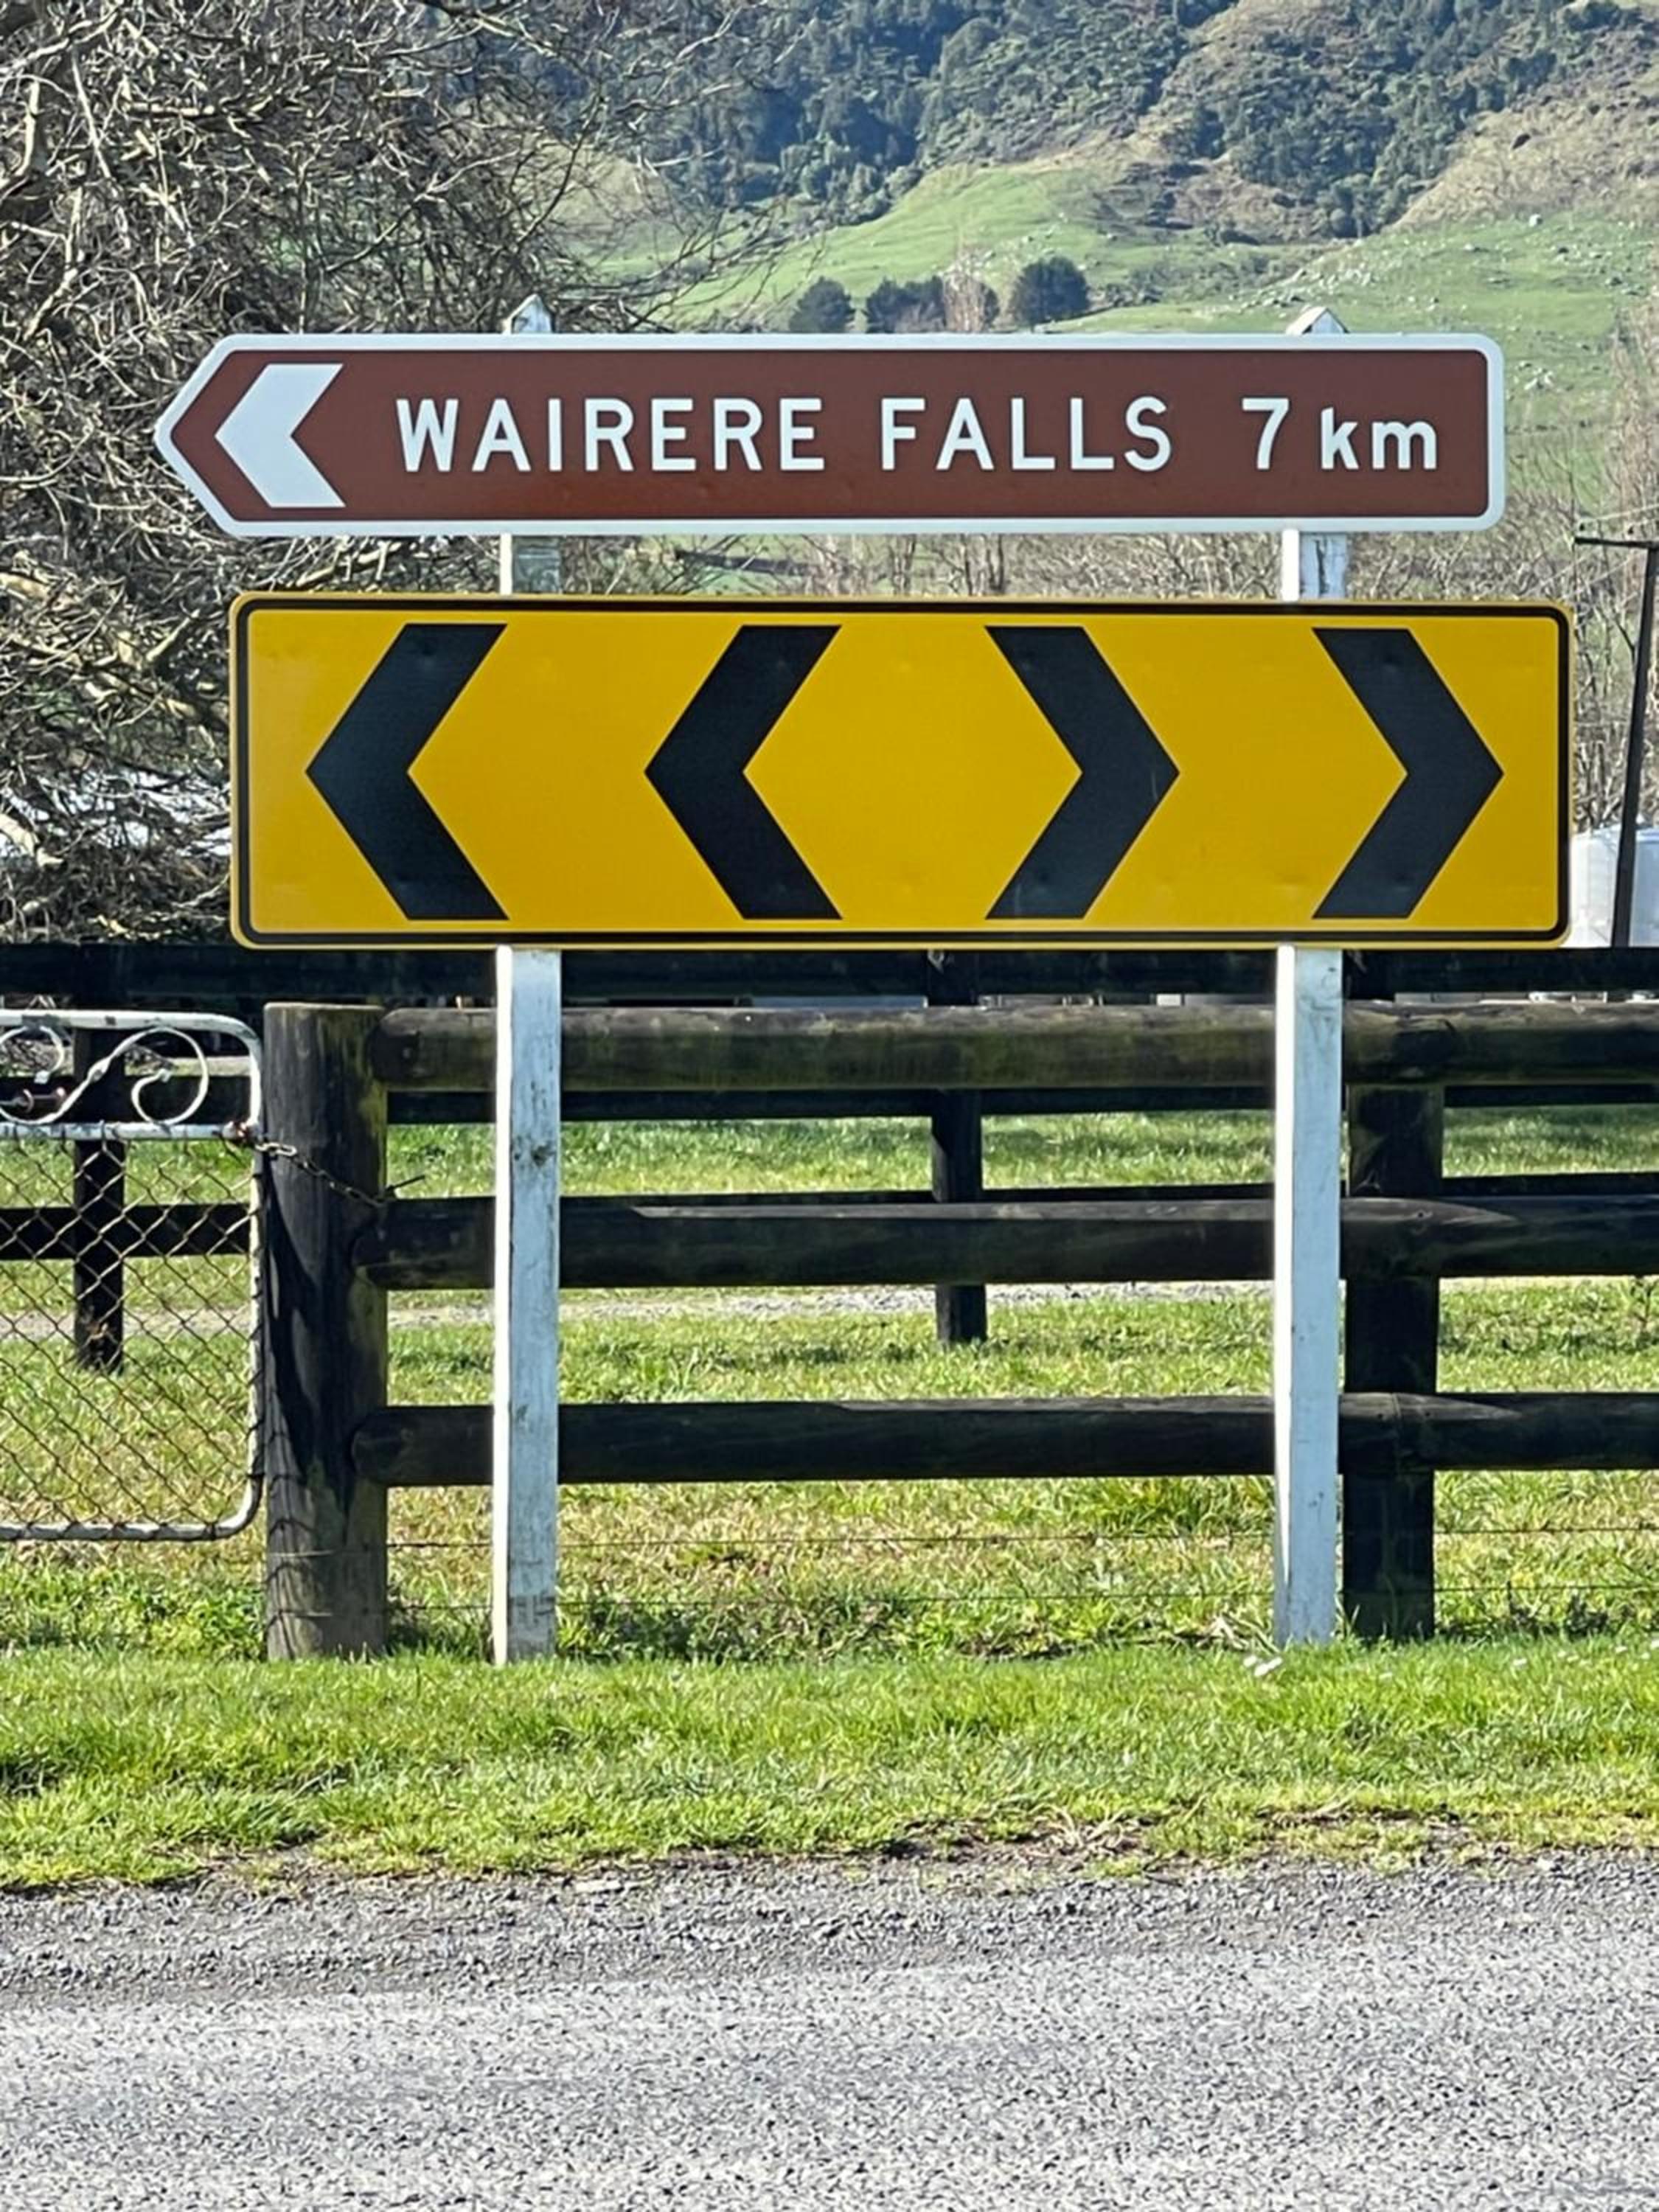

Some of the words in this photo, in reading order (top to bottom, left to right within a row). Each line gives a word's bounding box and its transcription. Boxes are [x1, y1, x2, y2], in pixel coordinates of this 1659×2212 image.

[396, 398, 824, 472] WAIRERE
[881, 397, 1171, 470] FALLS
[1242, 398, 1289, 470] 7
[1321, 407, 1436, 470] km
